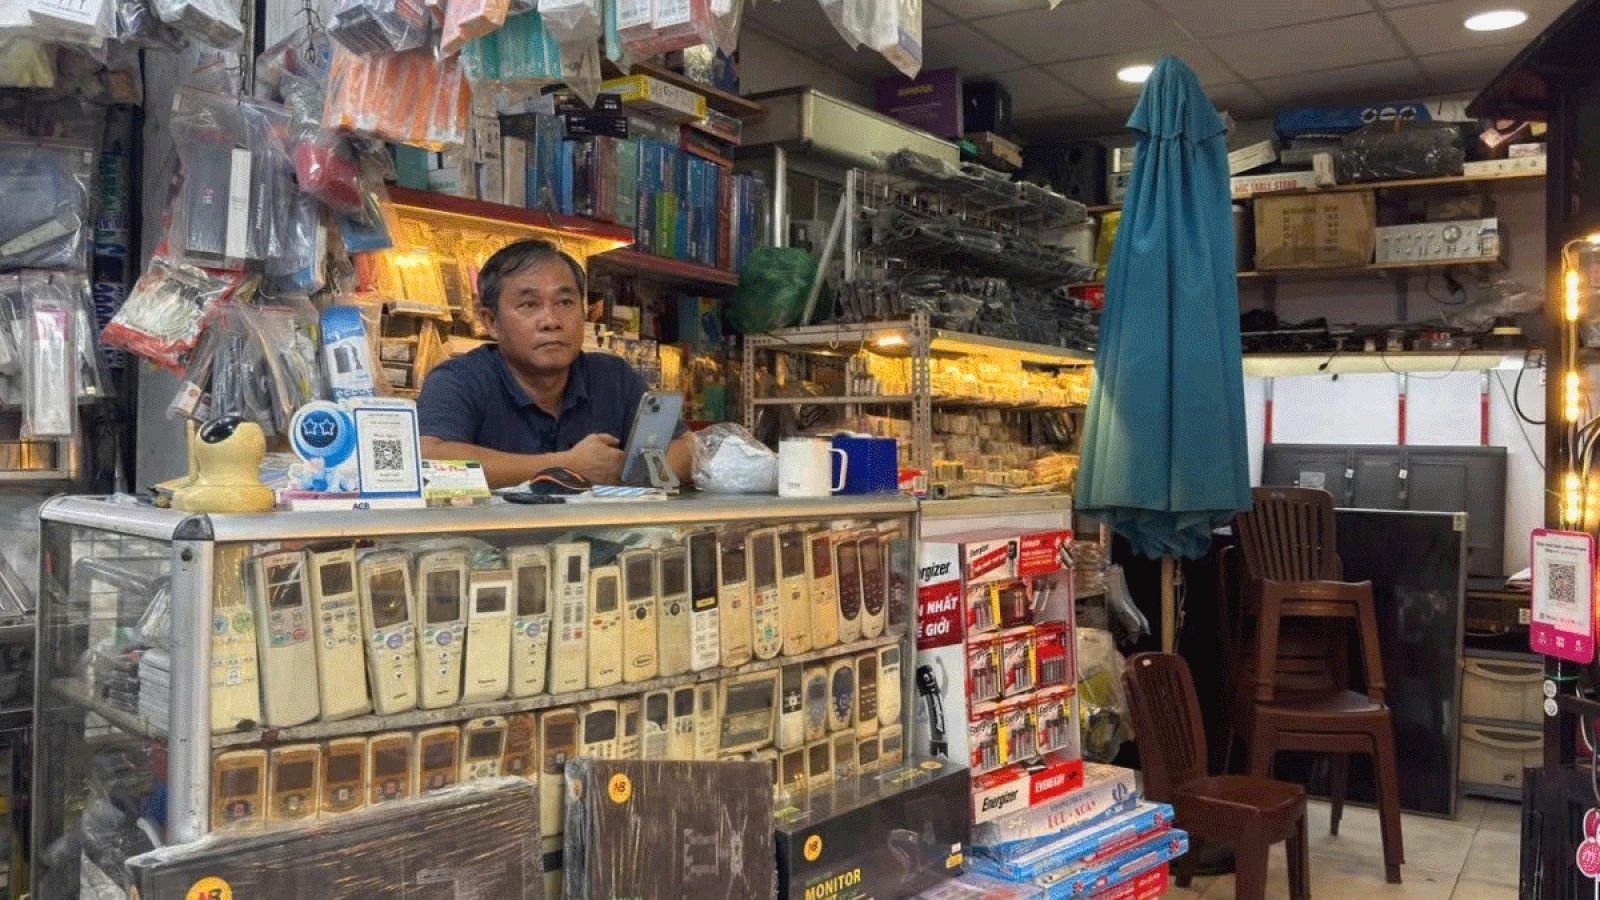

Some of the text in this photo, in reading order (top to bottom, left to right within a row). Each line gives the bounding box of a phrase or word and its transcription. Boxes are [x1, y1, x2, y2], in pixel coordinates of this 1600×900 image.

[353, 502, 370, 511] ACB
[919, 560, 951, 582] rgizer
[927, 593, 959, 614] NHẤT
[982, 789, 1019, 812] Energizer
[805, 867, 861, 900] MONITOR
